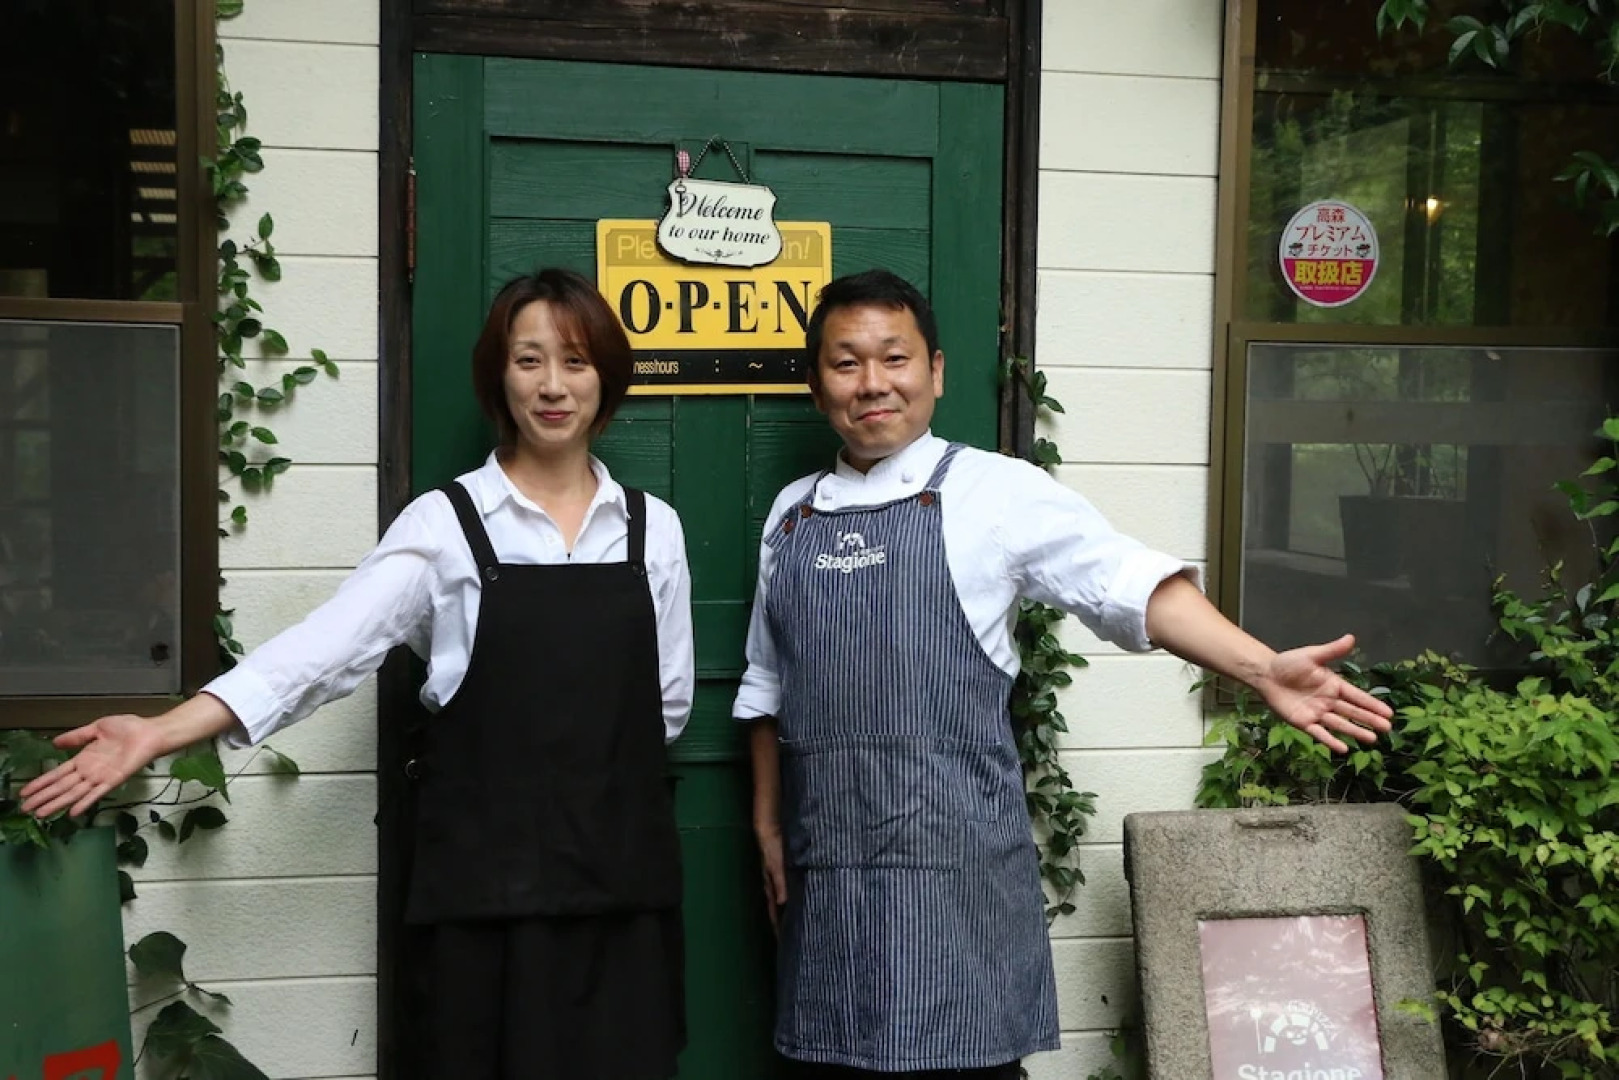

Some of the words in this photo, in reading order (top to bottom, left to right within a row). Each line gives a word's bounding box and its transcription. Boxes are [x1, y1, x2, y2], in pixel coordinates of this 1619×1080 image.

[679, 192, 765, 220] Welcome
[1317, 208, 1345, 222] 高森
[668, 224, 685, 239] to
[687, 227, 720, 240] our
[722, 226, 770, 244] home
[1296, 224, 1366, 242] プレミアム
[617, 234, 656, 260] Ple
[1308, 244, 1353, 257] チケット
[1294, 260, 1364, 286] 取扱店
[815, 551, 885, 574] Stagione
